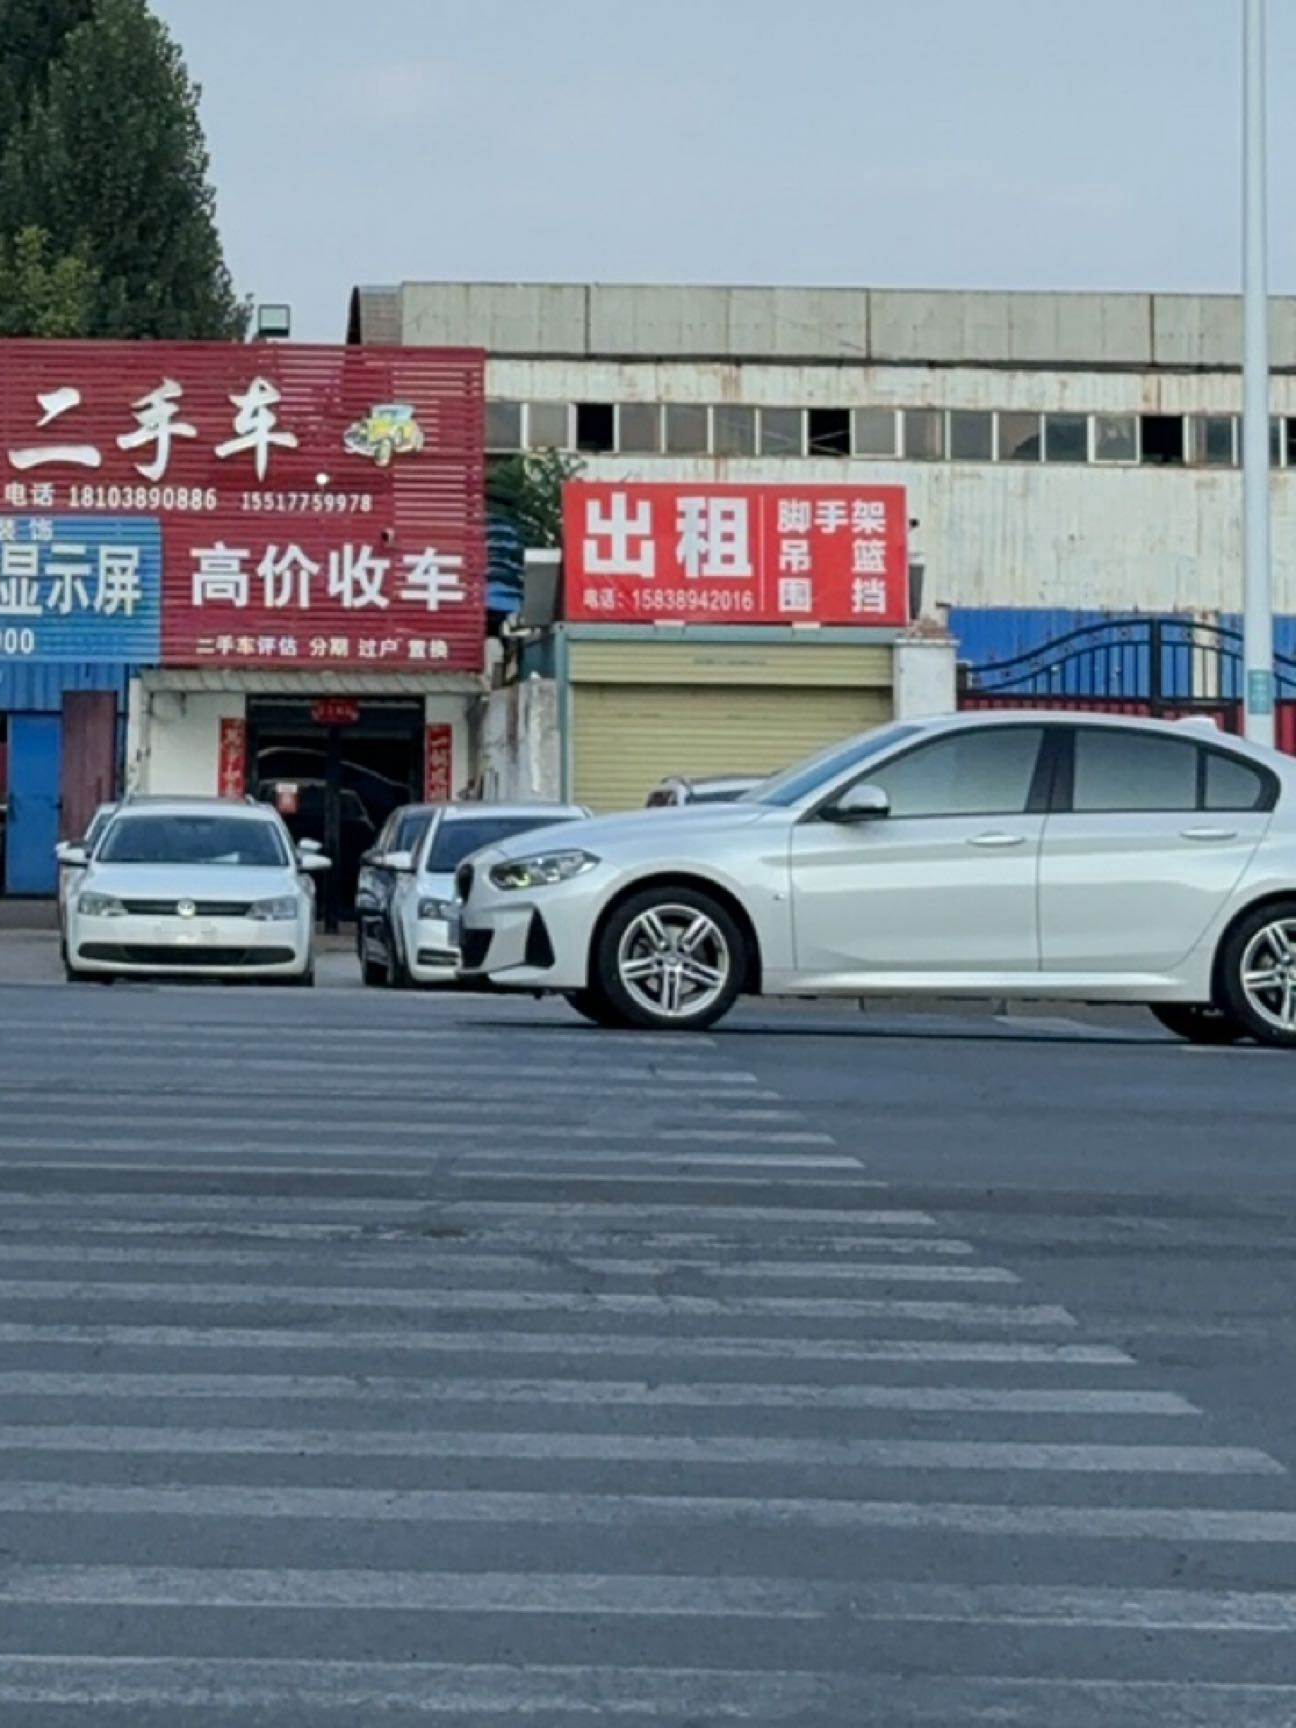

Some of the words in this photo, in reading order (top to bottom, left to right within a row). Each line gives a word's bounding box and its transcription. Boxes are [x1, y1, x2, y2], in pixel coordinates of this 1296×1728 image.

[5, 481, 55, 508] 电话
[69, 485, 217, 511] 18103890886
[241, 491, 373, 513] 15517759978
[777, 498, 886, 535] 脚手架
[583, 491, 752, 579] 出租
[189, 543, 465, 613] 高价收车
